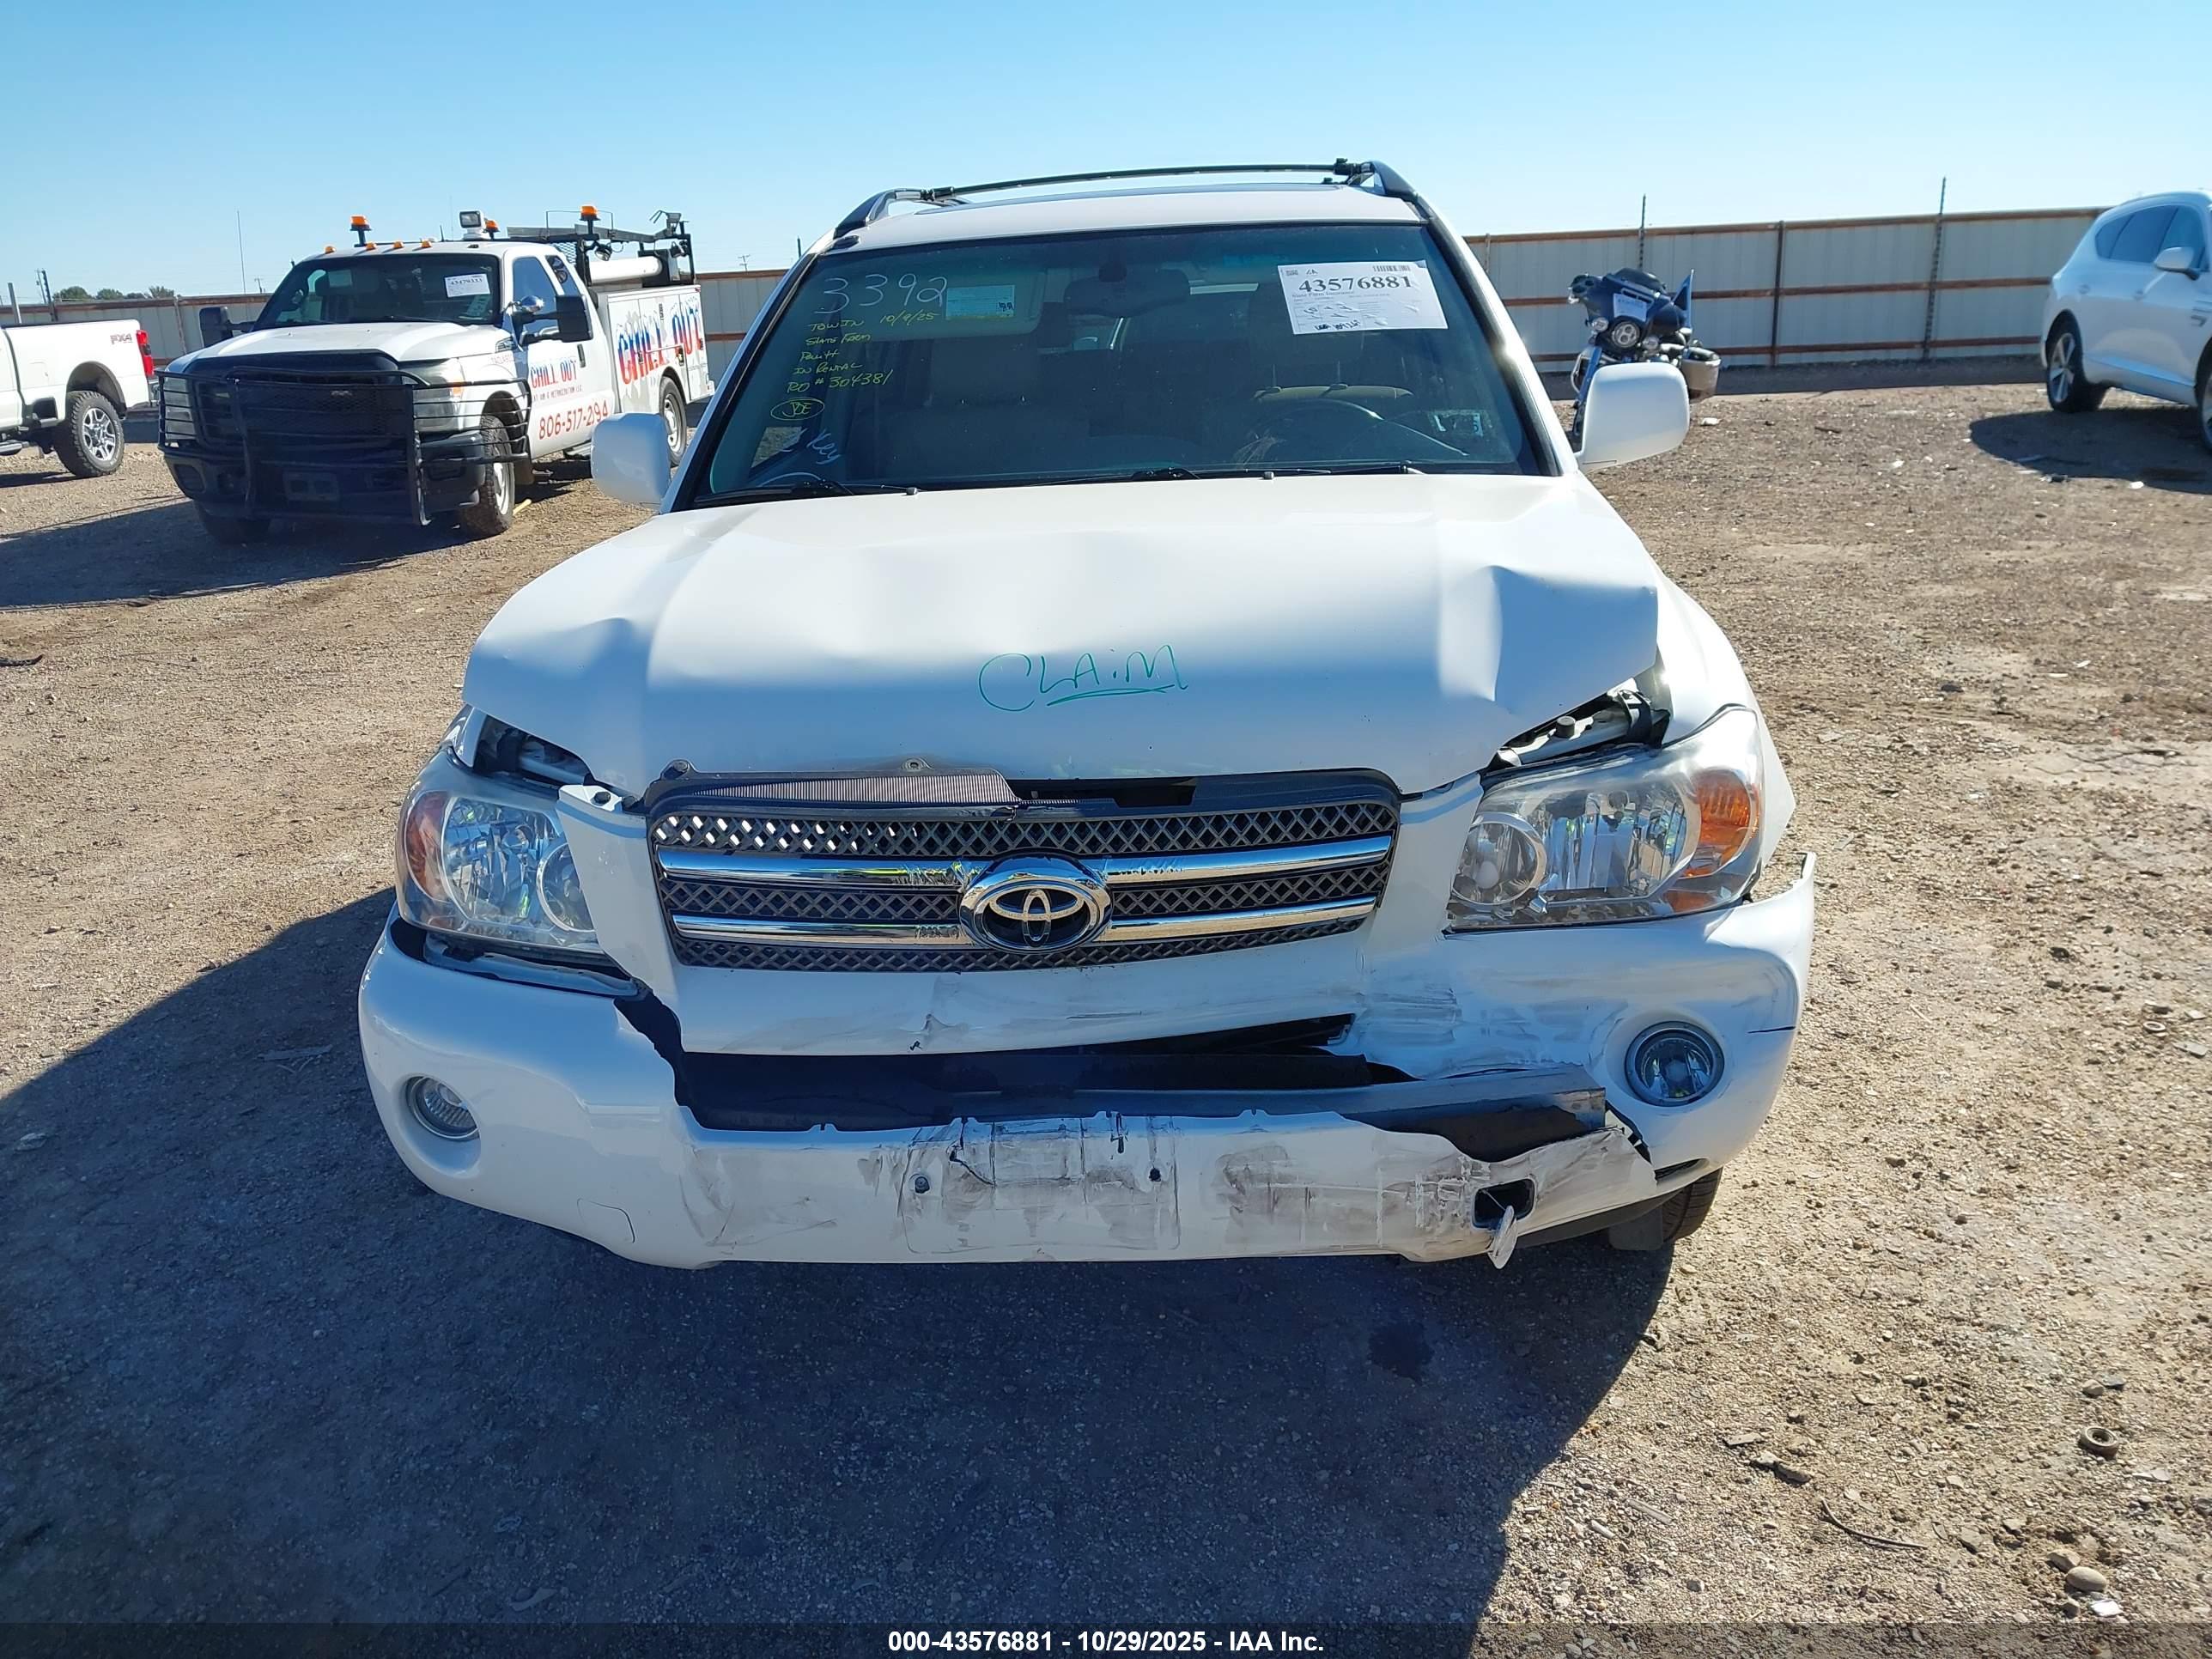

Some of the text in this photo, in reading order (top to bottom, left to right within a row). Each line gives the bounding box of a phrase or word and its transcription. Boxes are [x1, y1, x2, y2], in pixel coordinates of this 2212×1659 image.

[813, 273, 948, 313] 3392
[1298, 275, 1413, 293] 43576881
[530, 359, 577, 389] CHILL OUT
[829, 368, 894, 388] 304381
